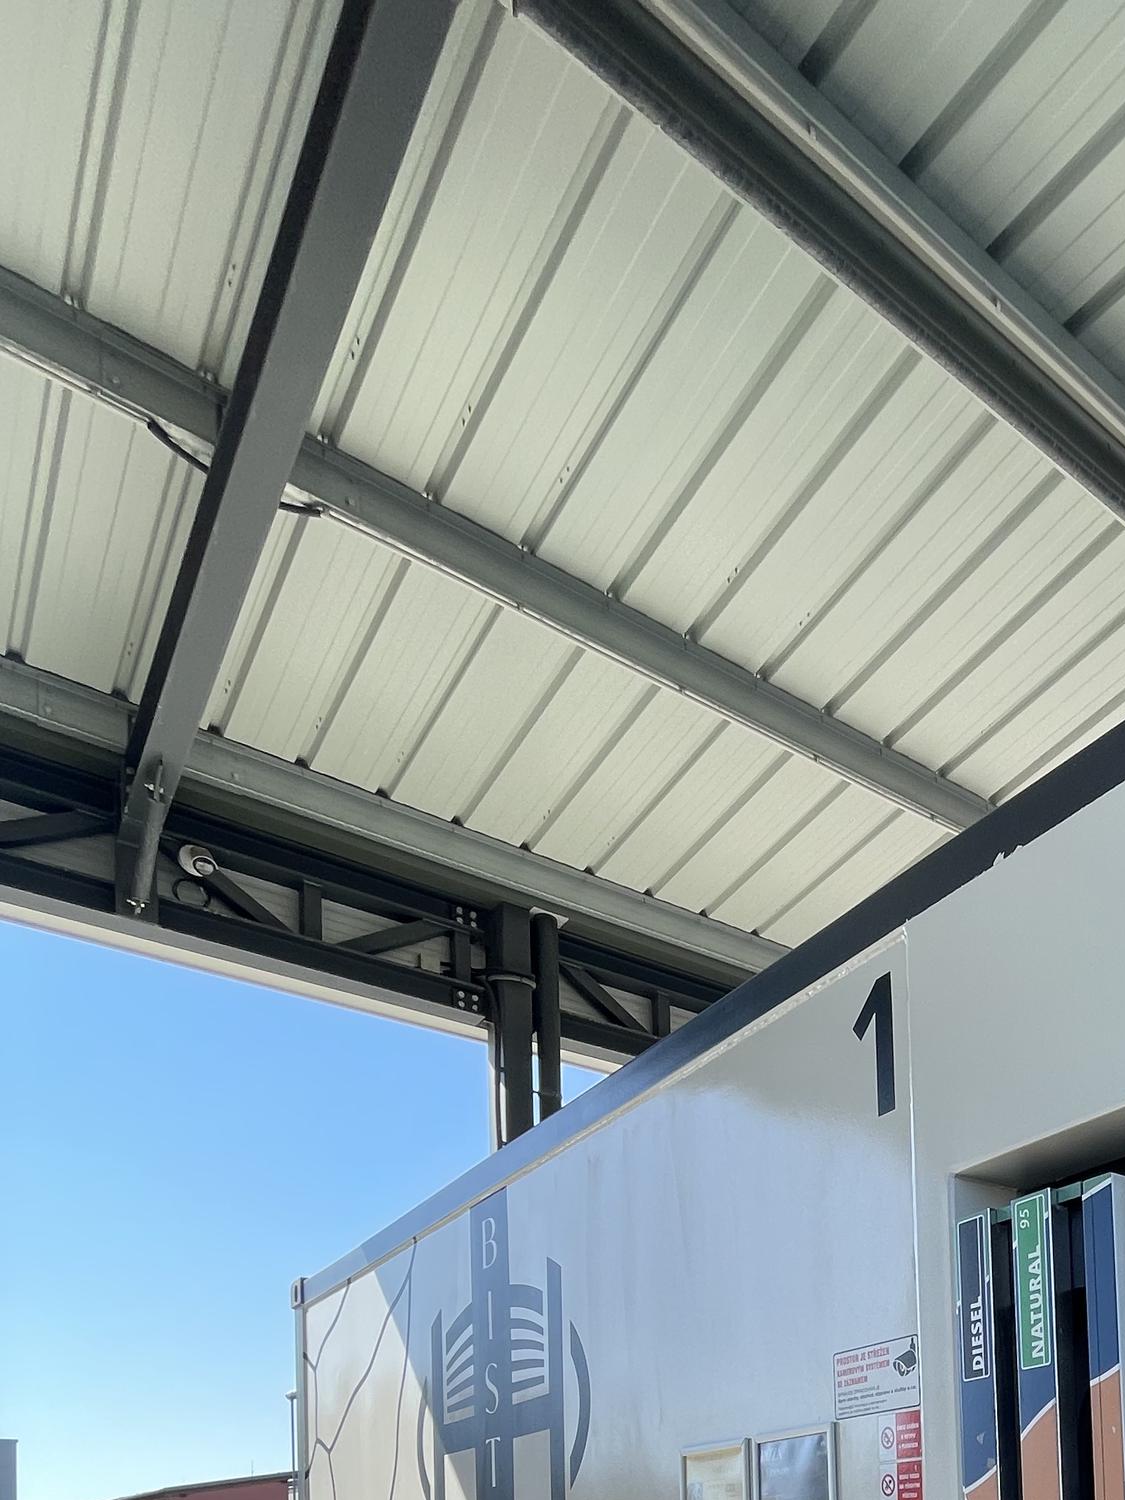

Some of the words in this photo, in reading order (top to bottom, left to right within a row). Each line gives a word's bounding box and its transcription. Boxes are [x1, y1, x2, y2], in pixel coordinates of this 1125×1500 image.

[852, 971, 896, 1117] 1
[1020, 1208, 1030, 1229] 95
[970, 1296, 984, 1372] DIESEL
[1028, 1244, 1044, 1359] NATURAL
